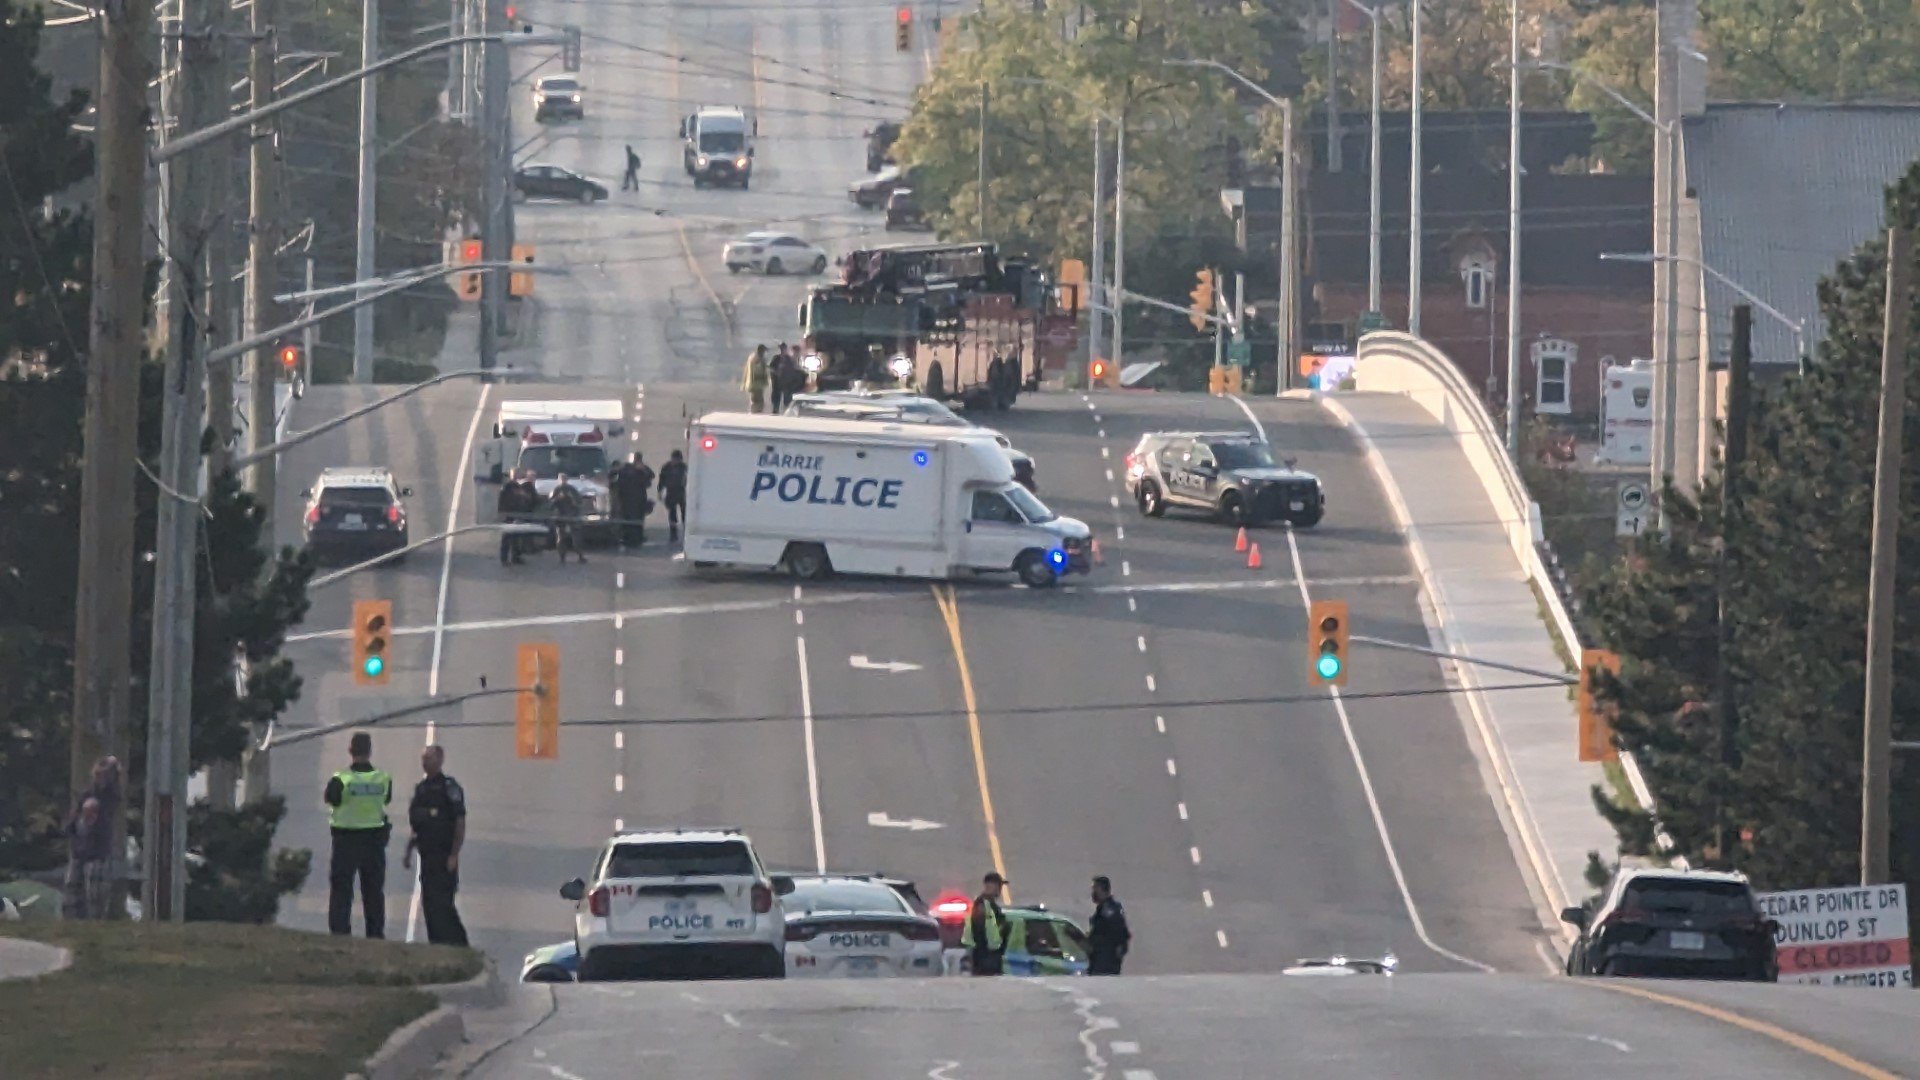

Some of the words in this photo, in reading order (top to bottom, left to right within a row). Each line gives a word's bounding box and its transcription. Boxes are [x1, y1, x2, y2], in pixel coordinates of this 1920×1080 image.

[750, 470, 904, 509] POLICE
[1759, 894, 1809, 916] CEDAR
[1816, 890, 1871, 912] POINTE
[1879, 888, 1899, 909] DR
[648, 914, 714, 930] POLICE
[1776, 920, 1848, 943] DUNLOP
[1857, 917, 1878, 938] ST
[829, 932, 890, 948] POLICE
[1795, 942, 1891, 968] CLOSED
